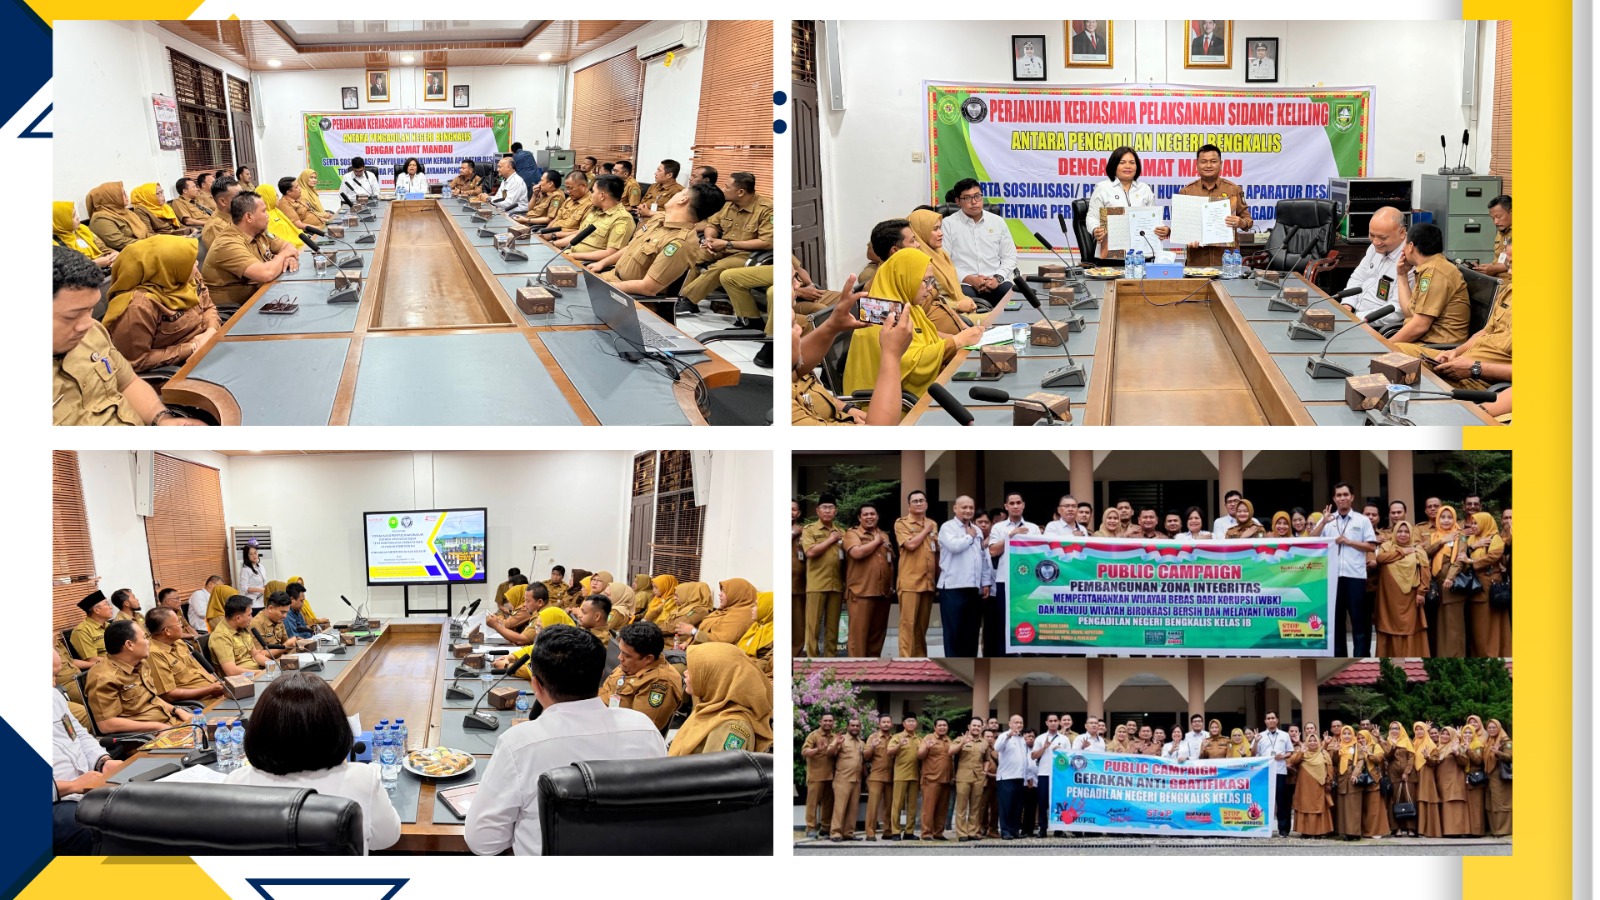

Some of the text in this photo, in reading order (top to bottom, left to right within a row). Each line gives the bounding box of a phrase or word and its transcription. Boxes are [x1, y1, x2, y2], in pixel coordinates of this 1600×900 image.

[990, 99, 1329, 126] PERJANJIAN KERJASAMA PELAKSANAAN SIDANG KELILING
[332, 117, 494, 130] PERJANJIAN KERJASAMA PELAKSANAAN SIDANG KELILING
[343, 132, 472, 143] ANTARA PENGADILAN NEGERI BENGKALIS
[1011, 131, 1282, 152] ANTARA PENGADILAN NEGERI BENGKALIS
[365, 145, 453, 154] DENGAN CAMAT MANDAU
[1058, 158, 1108, 176] DENGA
[1178, 159, 1243, 177] MAAU
[1004, 182, 1080, 199] SOSIALISASI/
[1246, 185, 1302, 199] APARATUR
[999, 204, 1047, 219] TENTANG
[1097, 564, 1242, 580] PUBLIC CAMPAIGN
[1070, 581, 1261, 593] PEMBANGUNAN ZONA INTEGRITAS
[1054, 593, 1282, 605] MEMPERTAHANKAN WILAYAH BEBAS DARI KORUPSI (WBK)
[1038, 605, 1296, 617] DAN MENUJU WILAYAH BIROKRASI BERSIH DAN MELAYANI (WBBM)
[1078, 616, 1131, 626] PENGADILAN
[1133, 617, 1162, 626] NEGERI
[1165, 618, 1211, 626] BENGKALIS
[1214, 618, 1240, 627] KELAS
[1242, 618, 1251, 627] IB
[1104, 760, 1217, 775] PUBLIC CAMPAIGN
[1074, 772, 1250, 790] GERAKAN ANTI GRATIFIKASI
[1066, 787, 1252, 804] PENGADILAN NEGERI BENGKALIS KELAS IB
